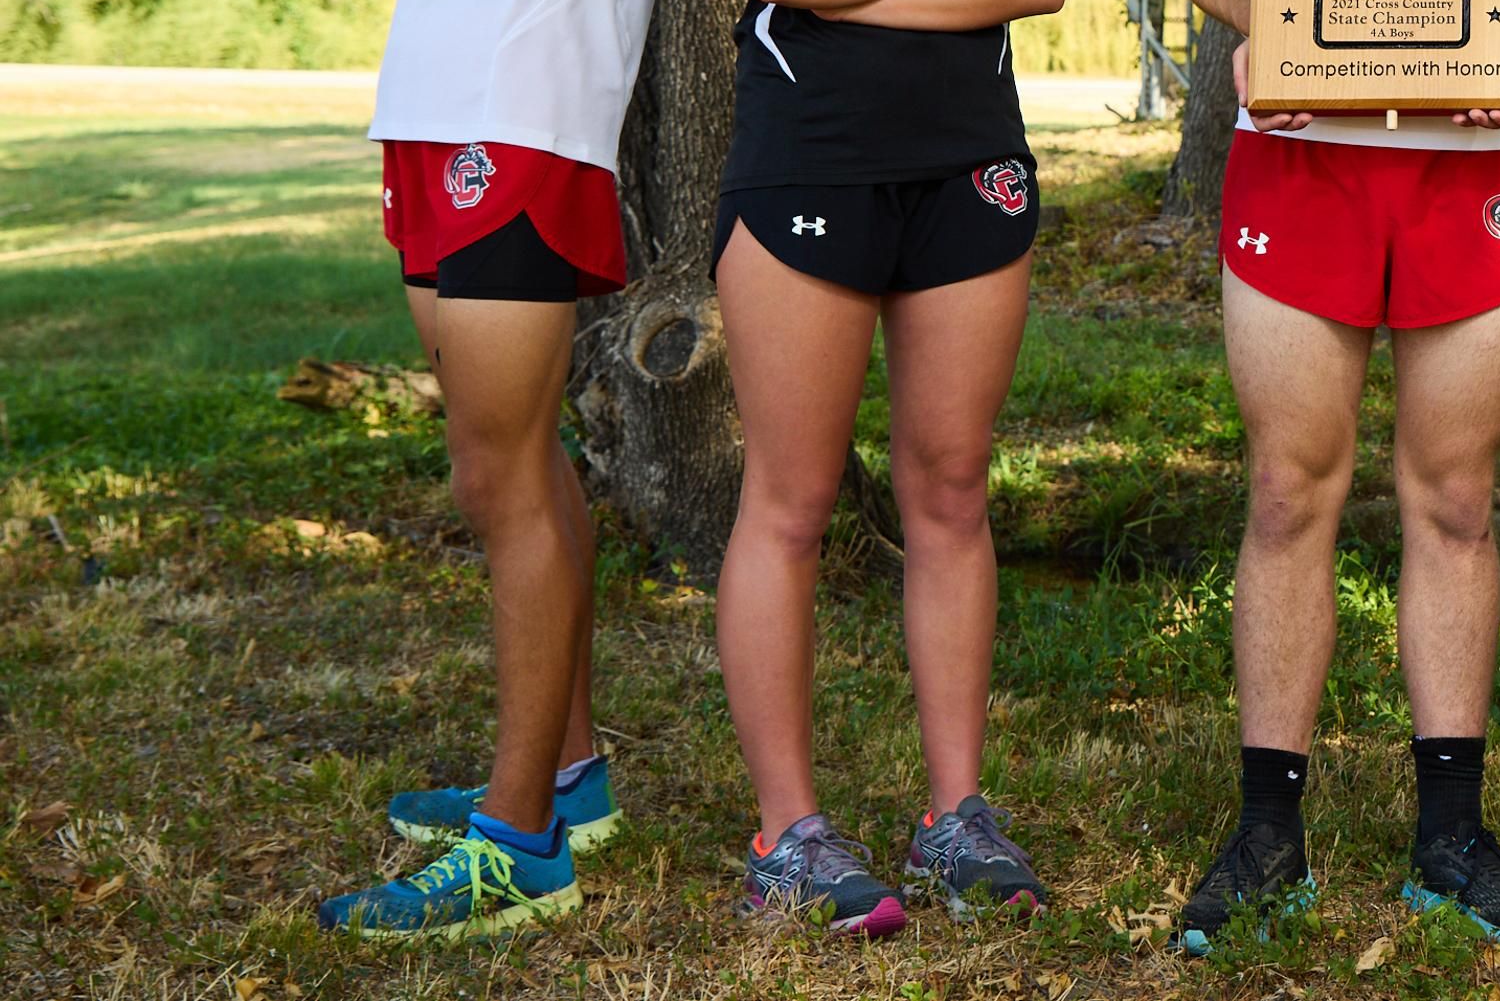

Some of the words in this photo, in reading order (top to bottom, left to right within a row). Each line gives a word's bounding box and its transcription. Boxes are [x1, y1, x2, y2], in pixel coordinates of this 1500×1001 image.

[1332, 0, 1359, 8] 2021
[1366, 0, 1398, 8] Cross
[1329, 12, 1367, 24] State
[1373, 12, 1455, 28] Champion
[1371, 29, 1385, 37] 4A
[1390, 29, 1414, 39] Boys
[1281, 61, 1395, 79] Competition
[1402, 61, 1439, 76] with
